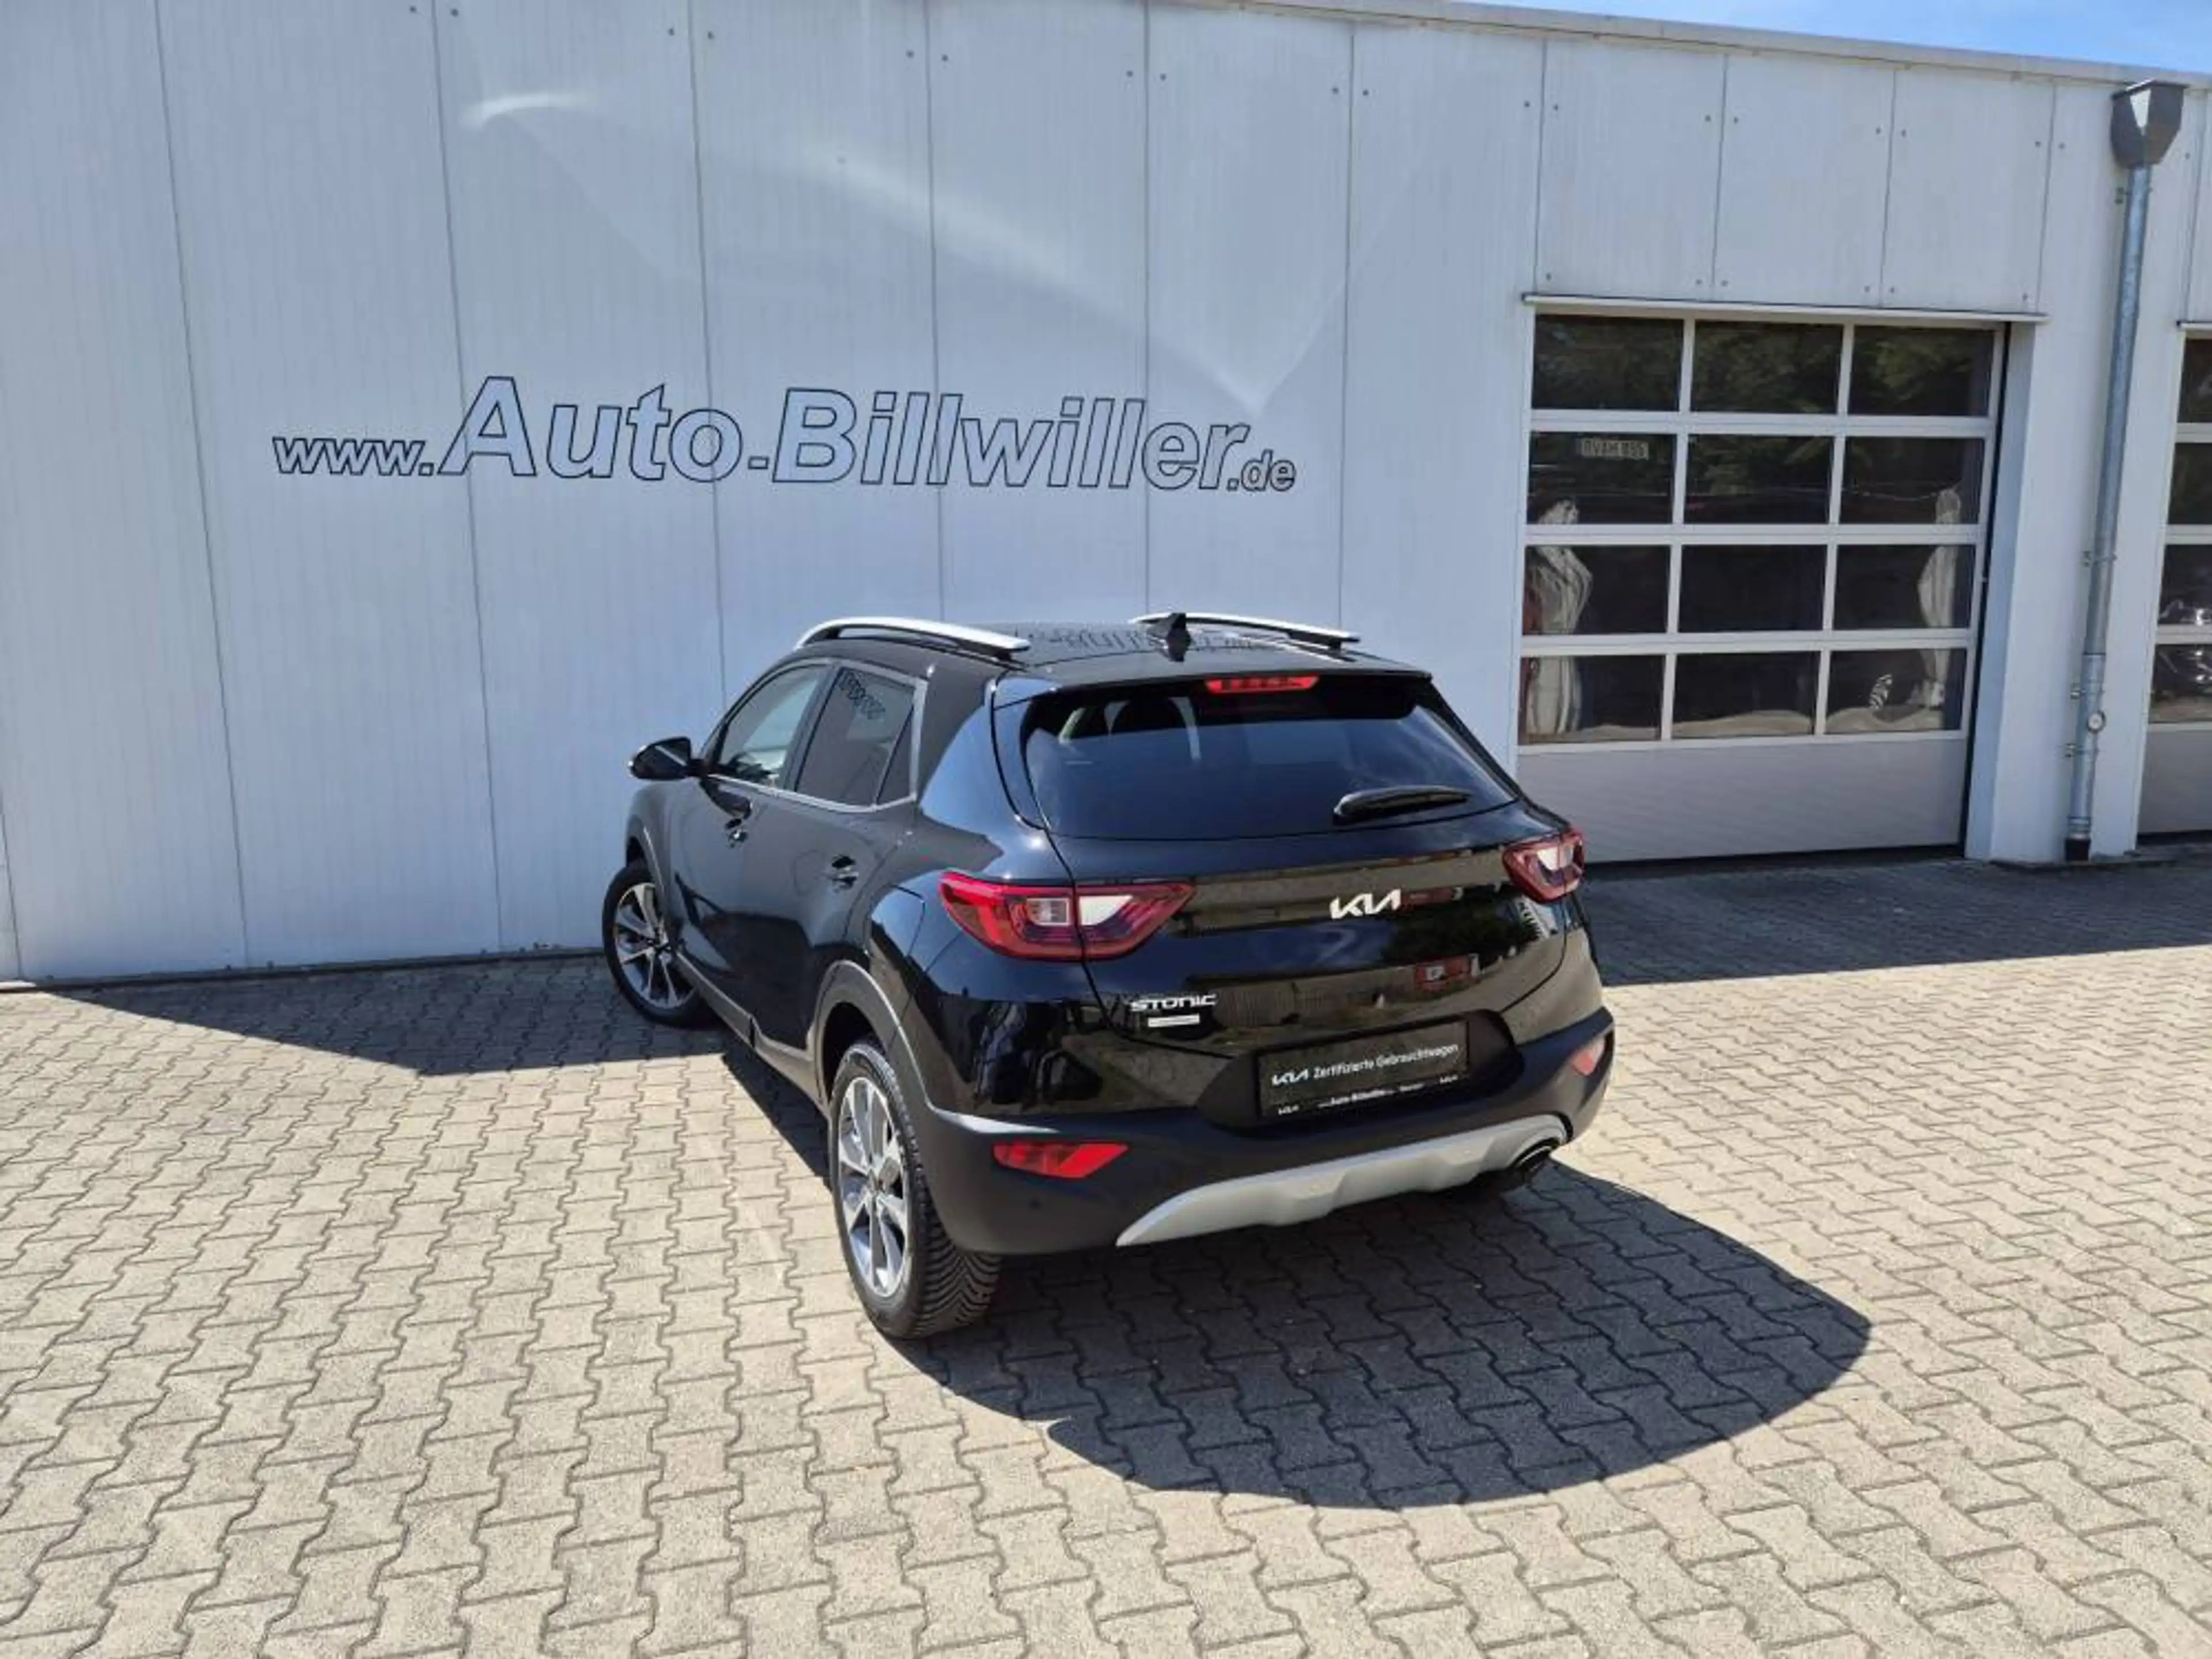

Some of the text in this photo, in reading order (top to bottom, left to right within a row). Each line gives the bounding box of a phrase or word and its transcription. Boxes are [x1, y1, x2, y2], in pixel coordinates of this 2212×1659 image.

[271, 376, 1297, 493] www.Auto-Billwiller.de
[1329, 888, 1402, 920] KIA
[1130, 993, 1217, 1012] STONIC
[1271, 1043, 1459, 1086] KIA Zertifizierte Gebrauchtwagen
